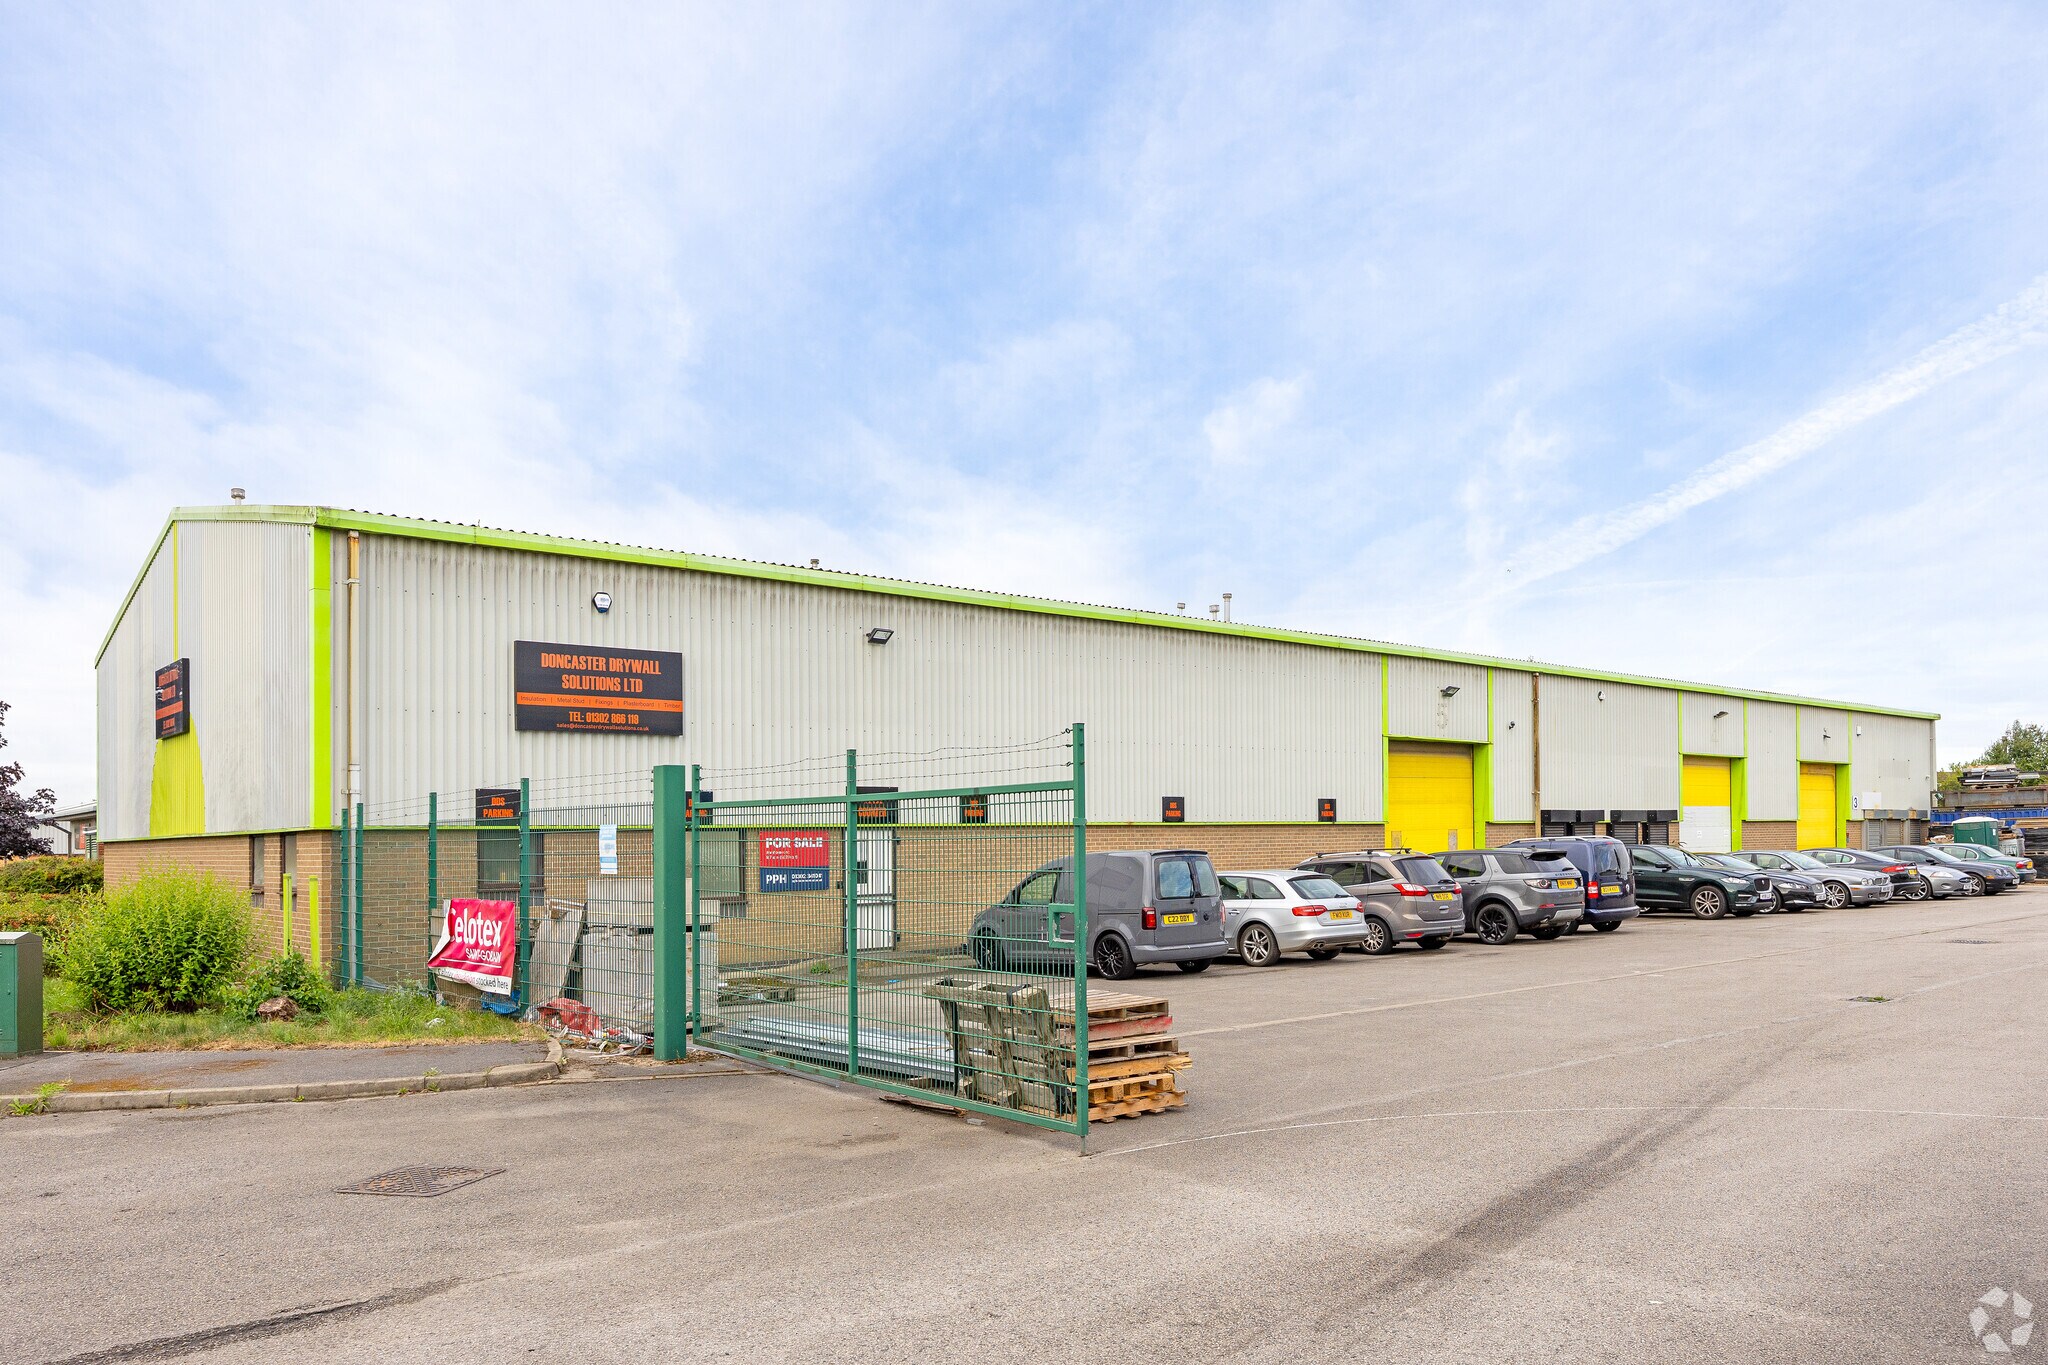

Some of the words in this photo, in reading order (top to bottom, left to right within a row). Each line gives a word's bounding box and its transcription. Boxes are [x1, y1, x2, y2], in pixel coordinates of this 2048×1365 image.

[541, 652, 607, 672] DONCASTER
[608, 657, 661, 675] DRYWALL
[561, 674, 621, 692] SOLUTIONS
[623, 677, 643, 693] LTD
[623, 700, 655, 708] Plasterboard
[569, 711, 584, 723] TEL:
[586, 712, 609, 724] 01302
[611, 713, 626, 724] 866
[491, 797, 506, 806] DDS
[1853, 797, 1858, 808] 3
[483, 808, 514, 818] PARKING
[765, 836, 791, 849] FOR
[794, 836, 823, 848] SALE
[766, 873, 787, 884] PPH
[476, 977, 497, 989] stocked
[496, 978, 509, 990] here
